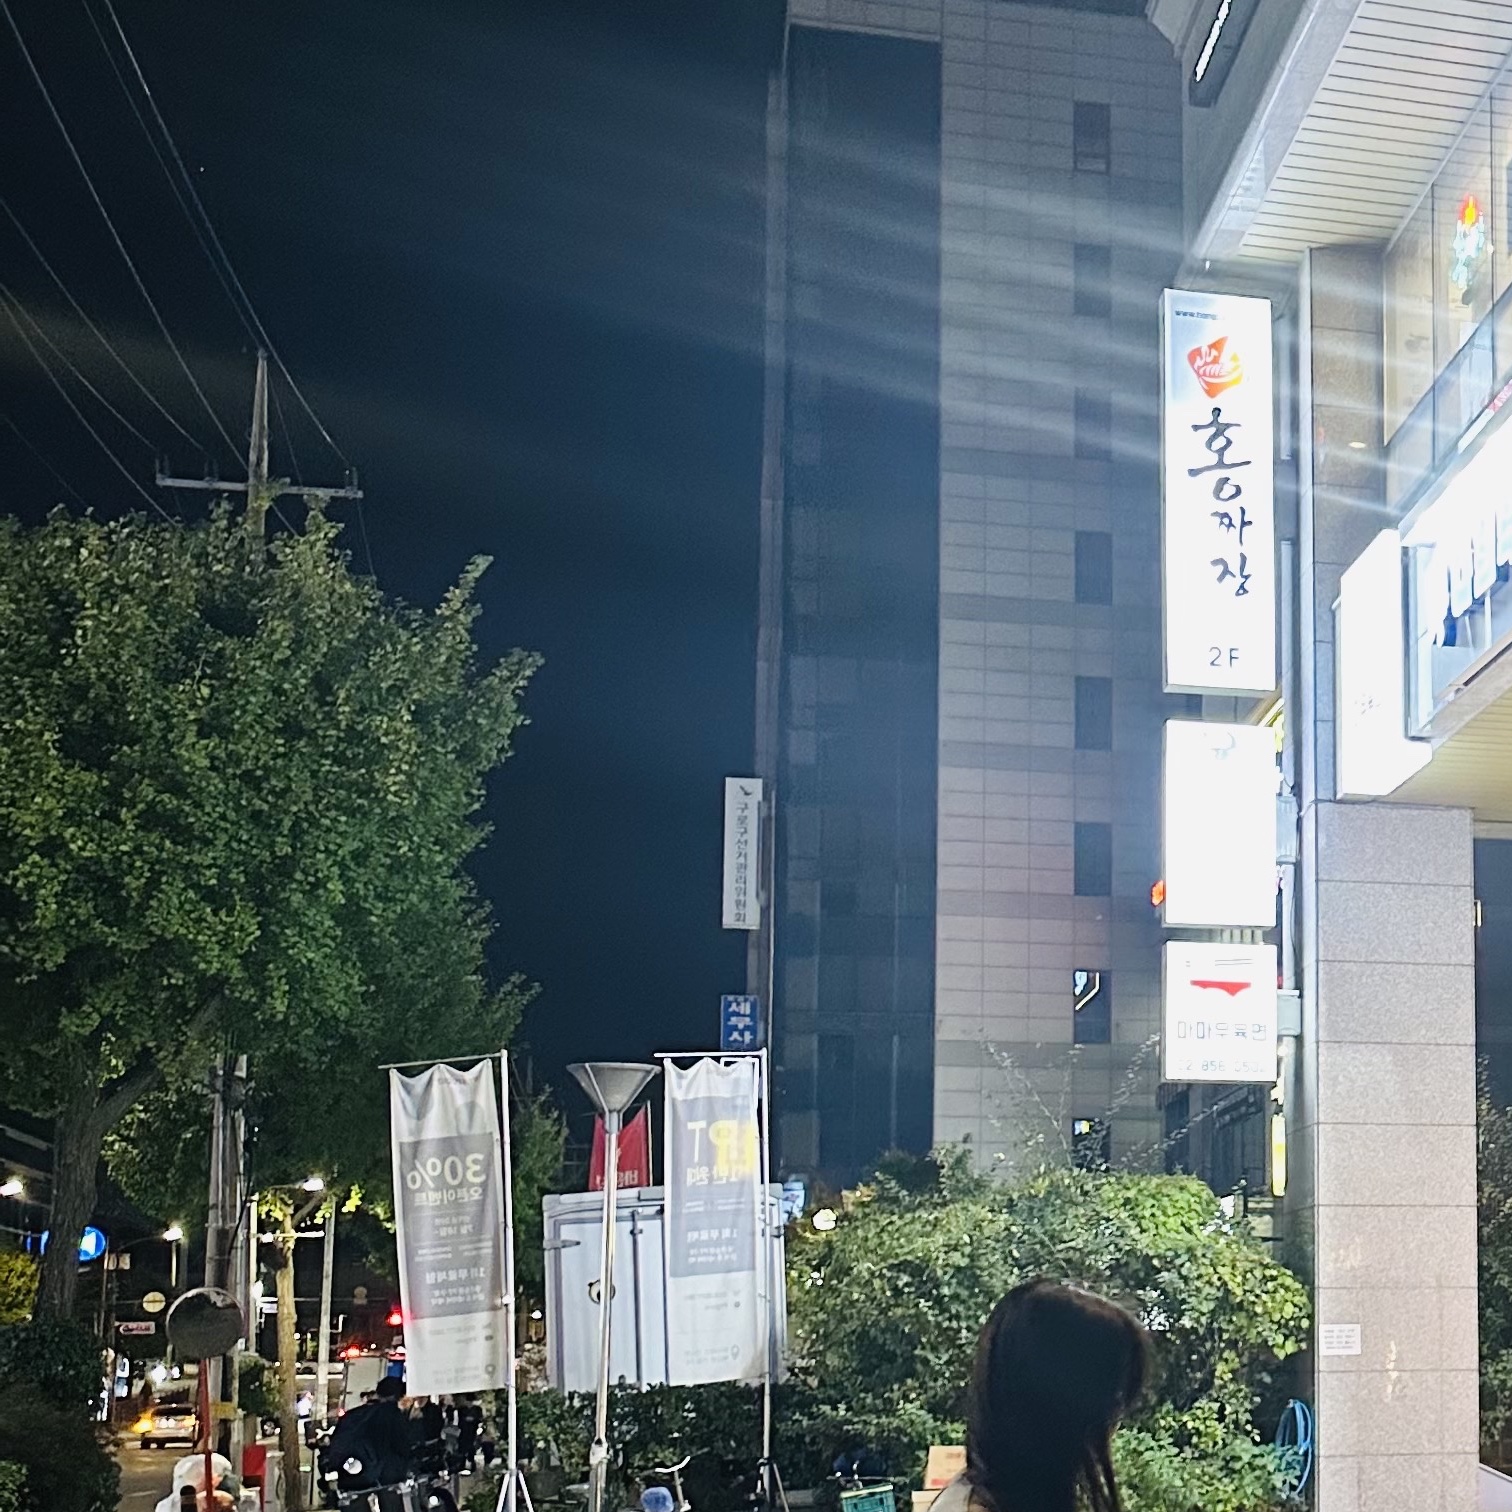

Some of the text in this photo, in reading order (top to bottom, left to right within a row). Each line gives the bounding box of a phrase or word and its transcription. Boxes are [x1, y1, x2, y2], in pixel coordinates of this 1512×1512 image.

[1188, 407, 1252, 596] 홍짜장
[1209, 646, 1240, 668] 2F
[726, 1001, 753, 1046] 세무사
